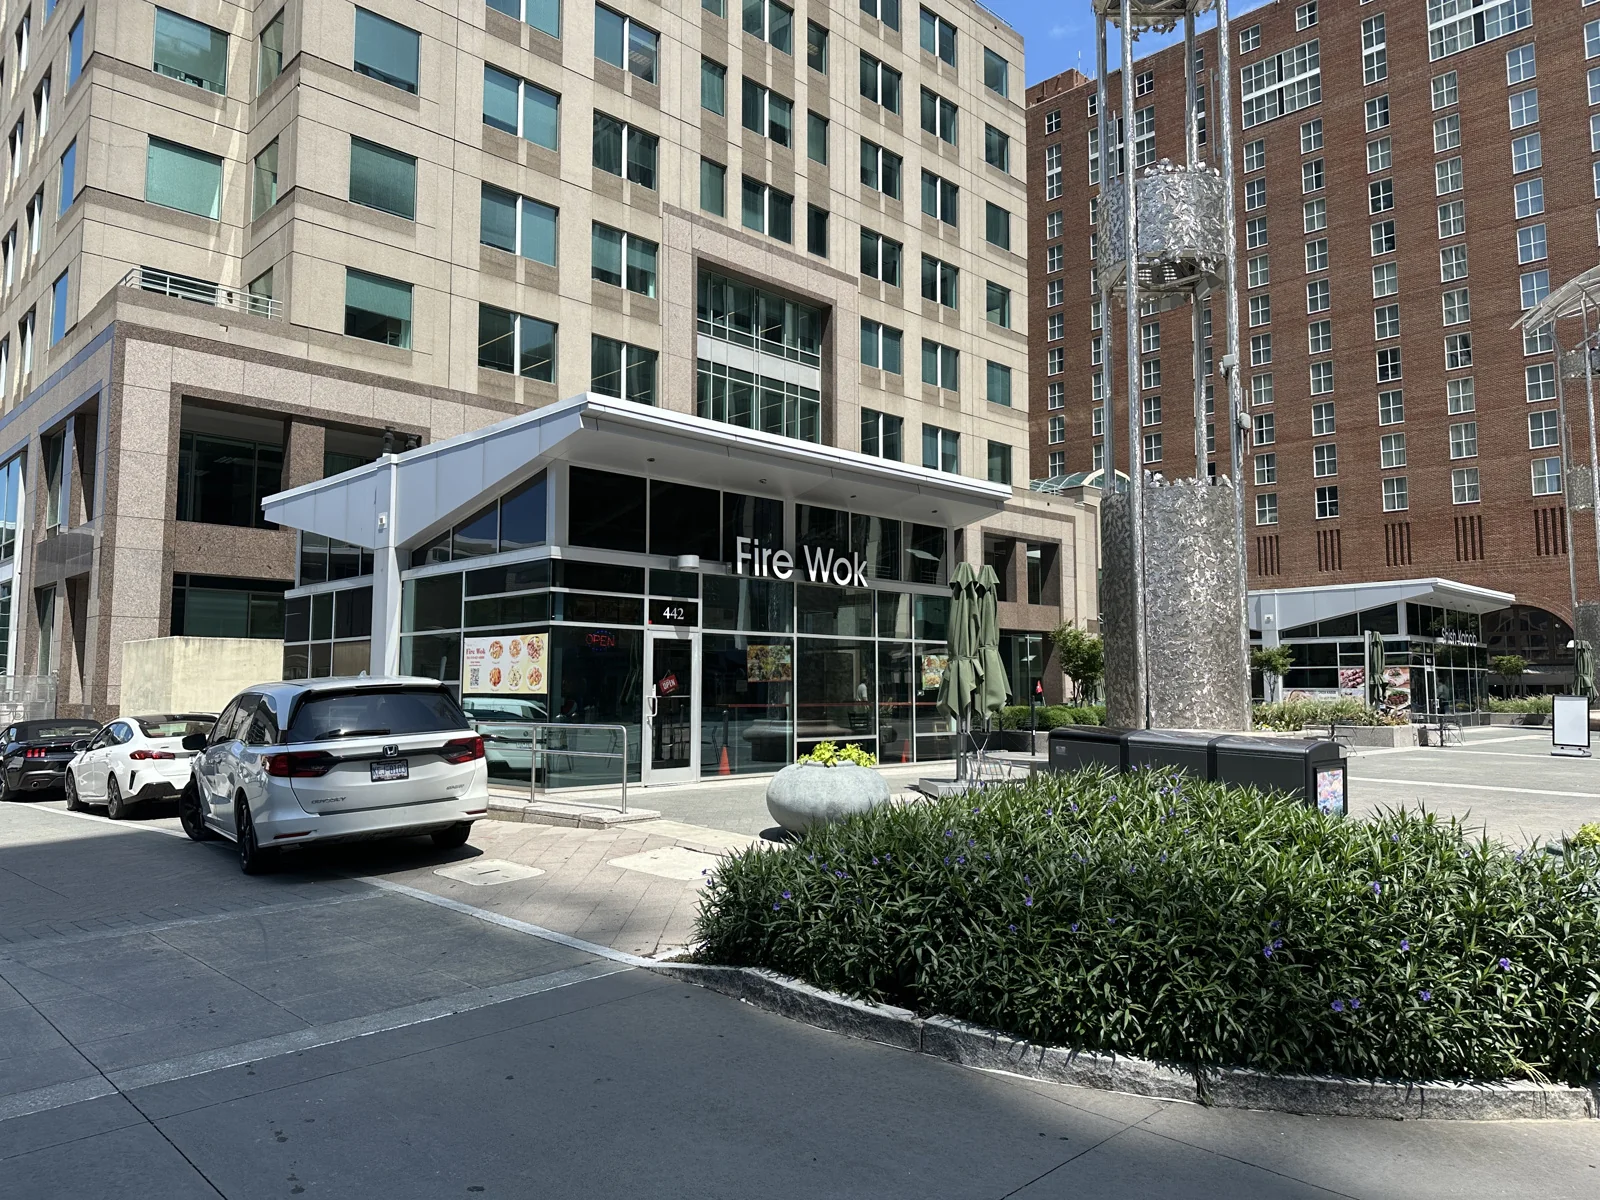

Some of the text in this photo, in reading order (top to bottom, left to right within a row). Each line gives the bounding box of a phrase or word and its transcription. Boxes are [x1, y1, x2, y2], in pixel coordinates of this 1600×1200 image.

[736, 535, 869, 588] Fire Wok
[662, 606, 685, 620] 442
[585, 633, 615, 647] OPEN
[1441, 627, 1457, 645] Shish
[662, 679, 676, 690] OPEN
